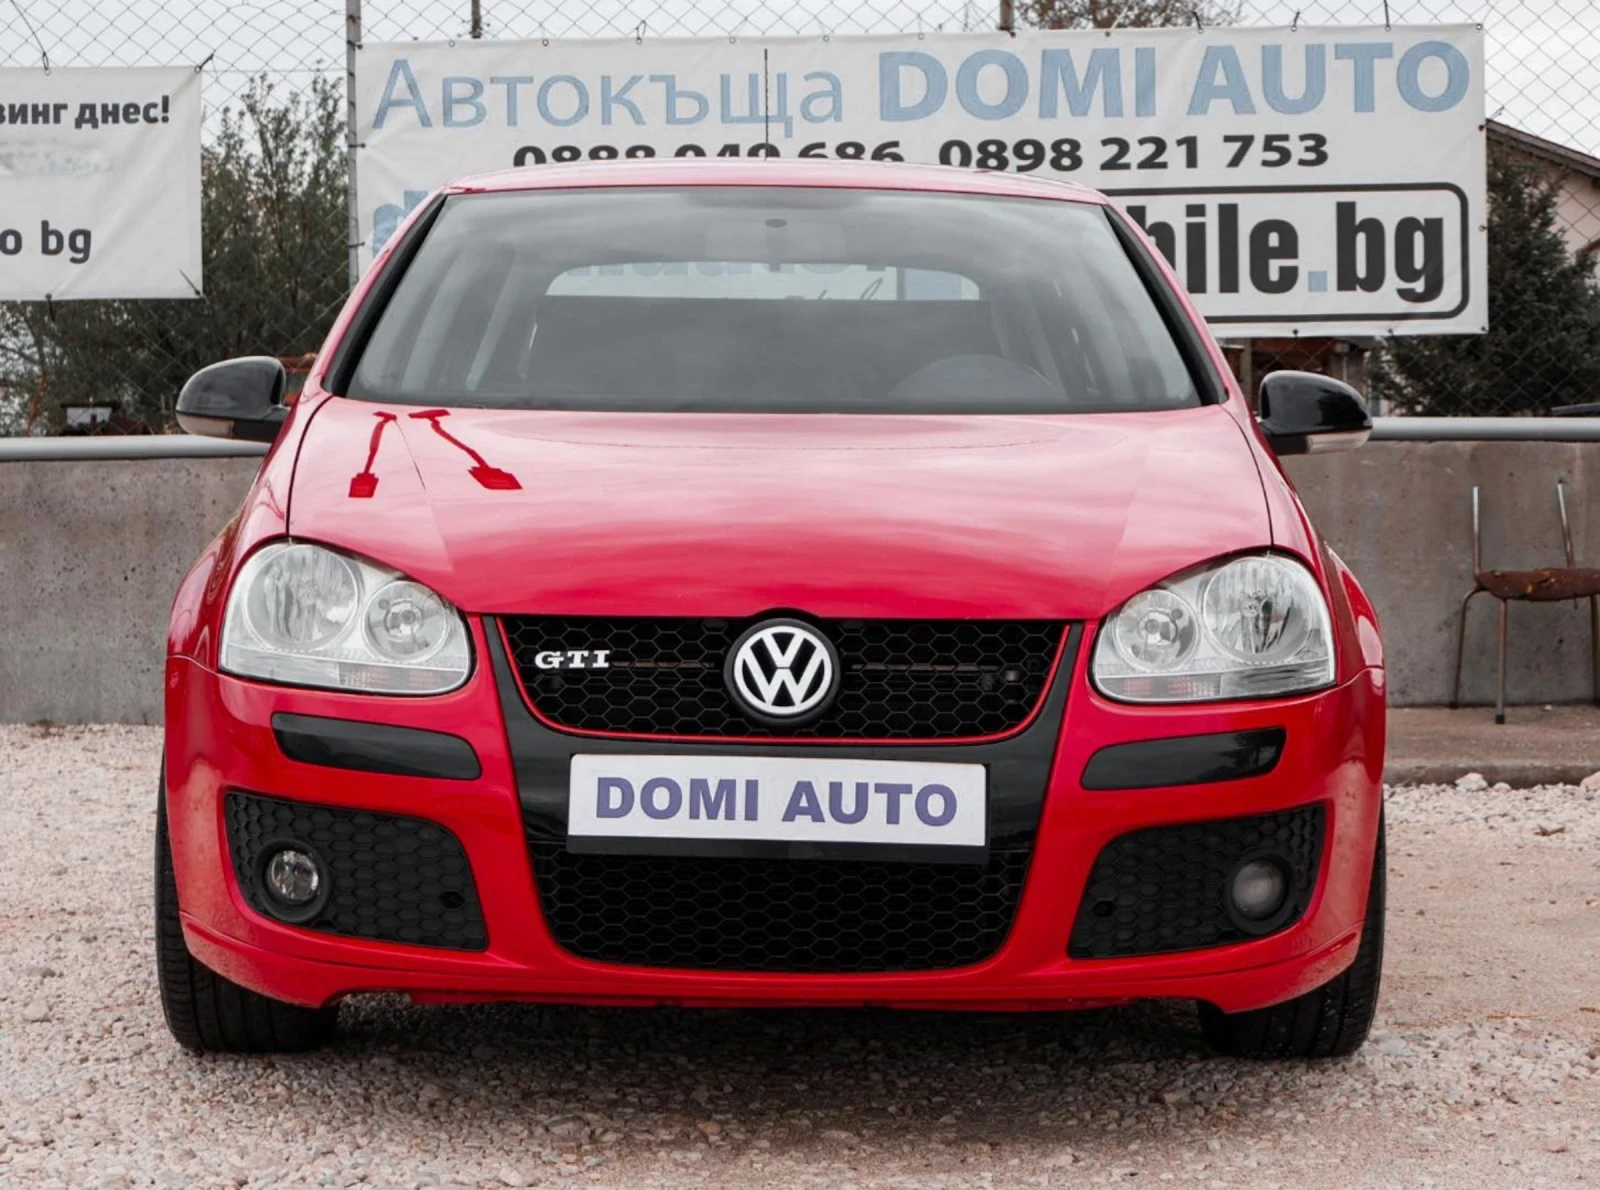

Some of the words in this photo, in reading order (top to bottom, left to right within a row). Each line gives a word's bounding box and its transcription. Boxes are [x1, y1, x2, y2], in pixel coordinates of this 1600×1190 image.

[374, 58, 843, 137] Автокъща
[878, 47, 1157, 122] DOMI
[1186, 40, 1470, 116] AUTO
[74, 95, 170, 129] днес!
[938, 138, 1083, 172] 0898
[1099, 135, 1198, 171] 221
[1223, 133, 1329, 167] 753
[41, 219, 92, 265] bg
[535, 650, 610, 669] GTI
[596, 777, 759, 821] DOMI
[782, 781, 958, 827] AUTO
